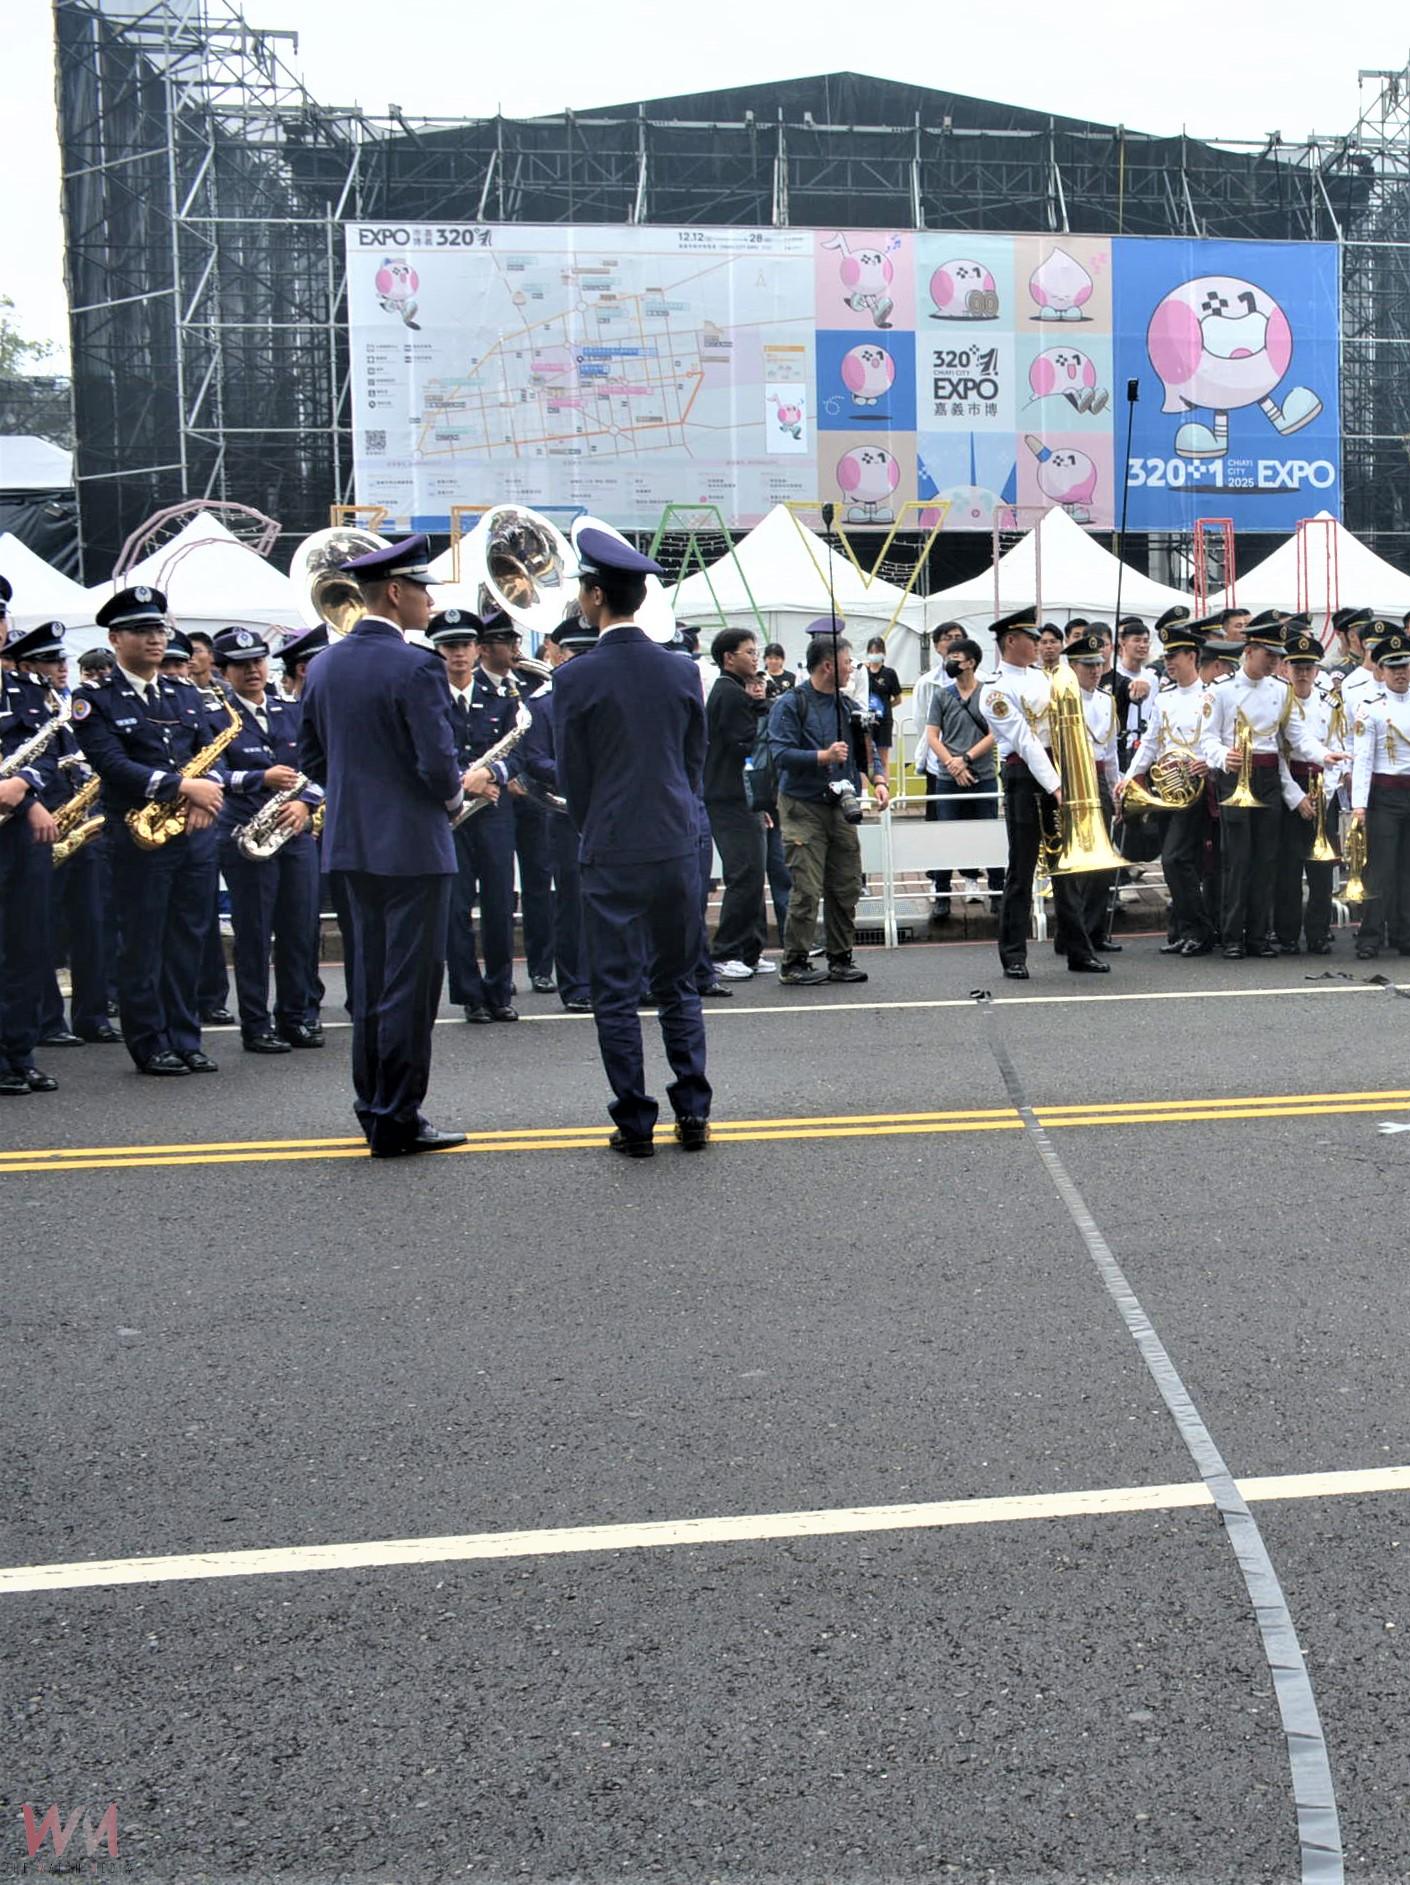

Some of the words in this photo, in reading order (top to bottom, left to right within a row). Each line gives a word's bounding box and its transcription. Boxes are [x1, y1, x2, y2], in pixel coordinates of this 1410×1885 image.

[359, 228, 410, 246] EXPO
[934, 377, 999, 400] EXPO
[934, 402, 998, 417] 嘉義市博
[1227, 468, 1246, 476] CITY
[1257, 459, 1336, 489] EXPO
[1227, 477, 1255, 488] 2025
